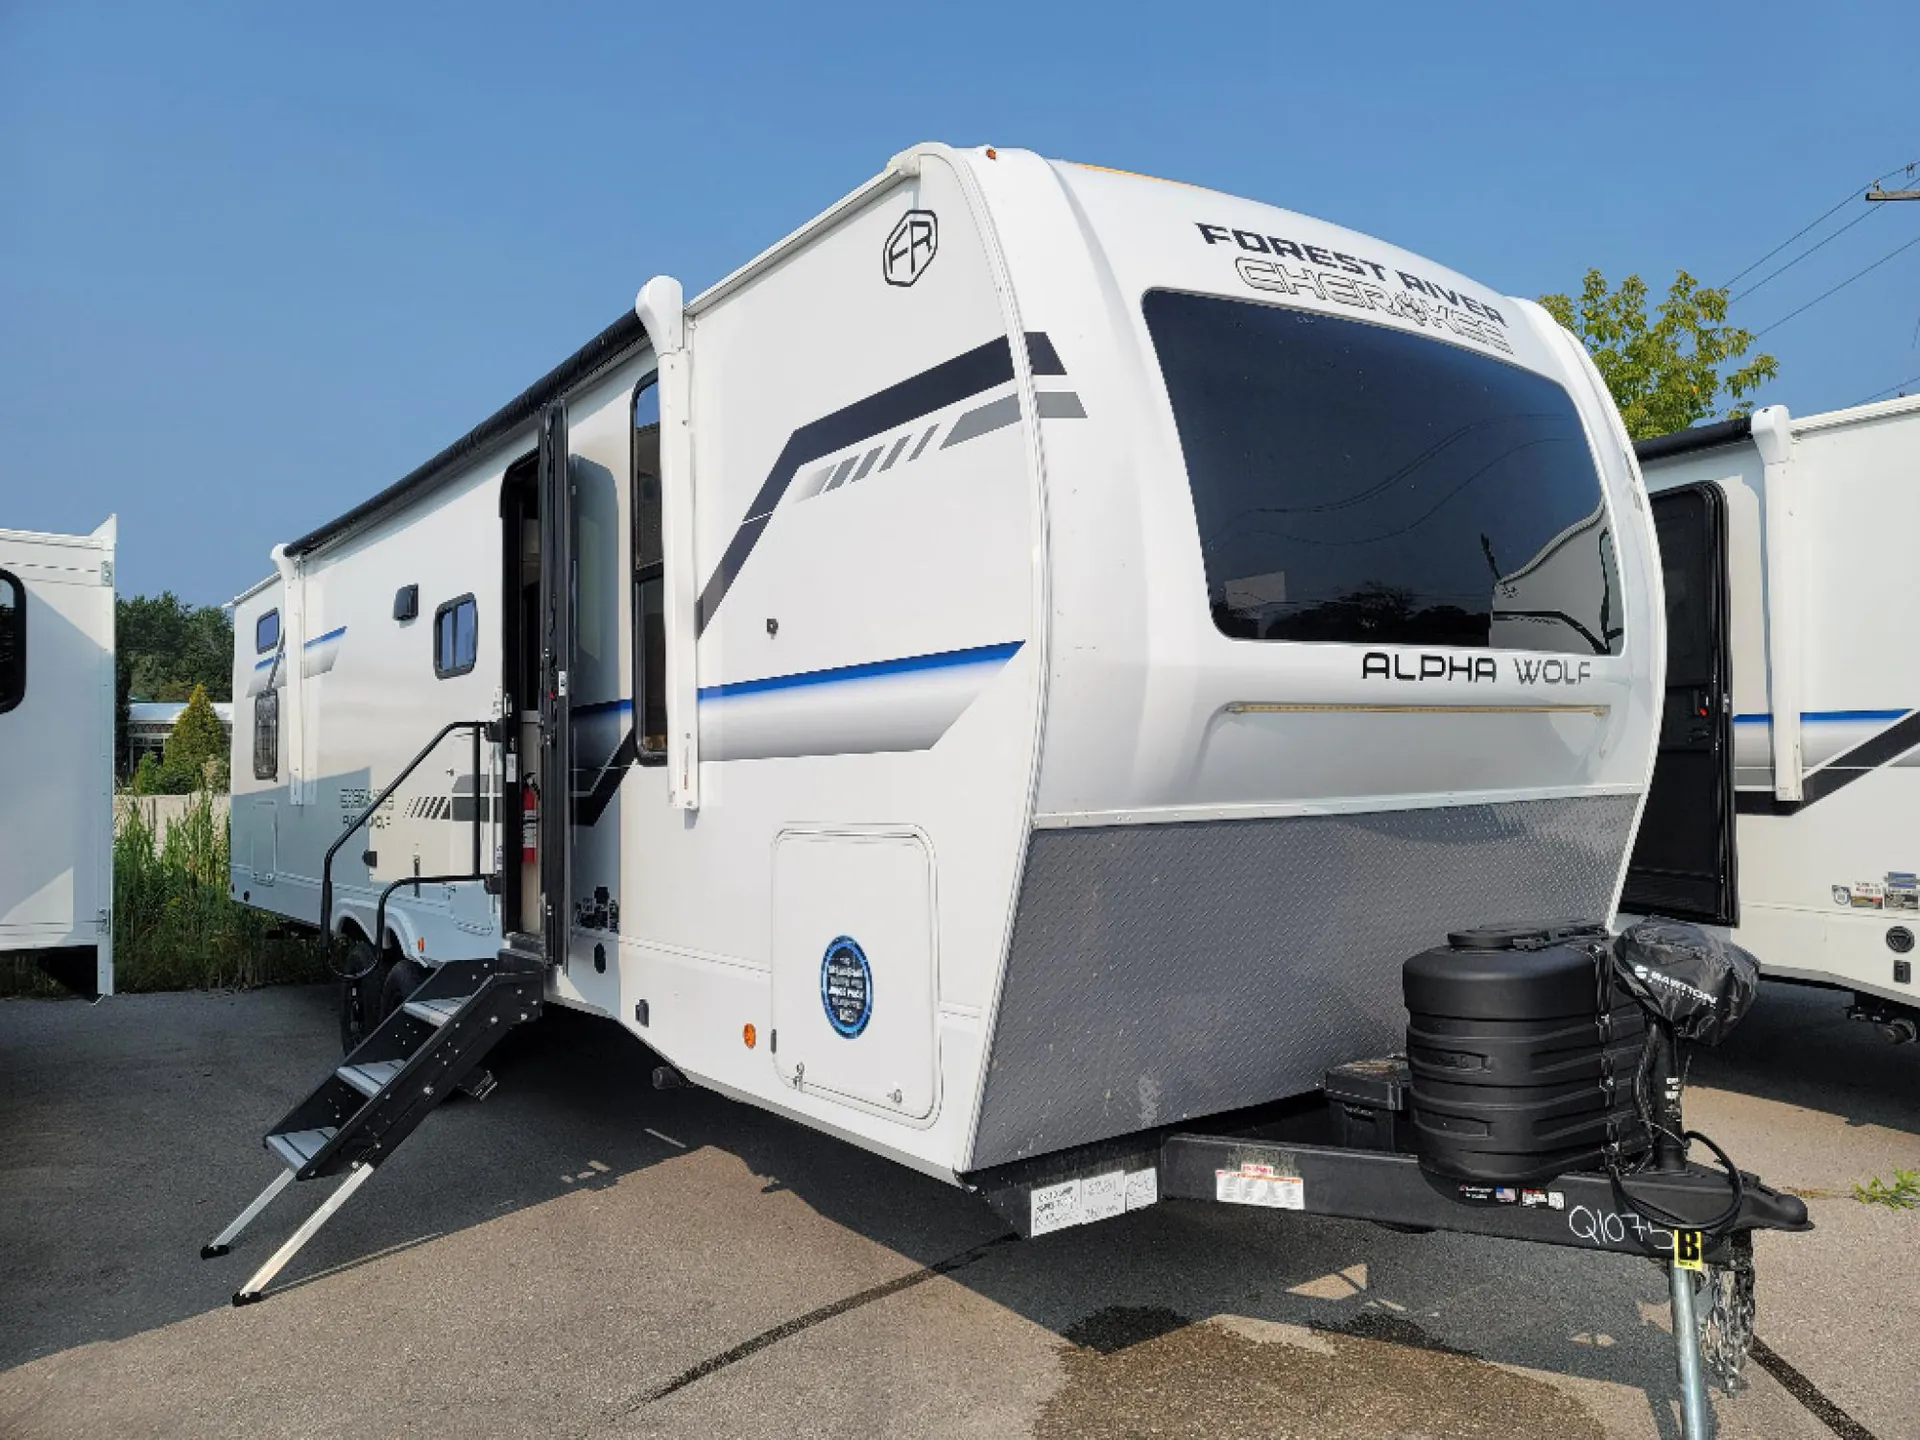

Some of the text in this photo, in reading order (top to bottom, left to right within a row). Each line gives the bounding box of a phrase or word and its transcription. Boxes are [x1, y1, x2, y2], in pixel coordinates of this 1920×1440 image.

[1195, 222, 1509, 328] FOREST RIVER
[1235, 256, 1515, 355] CHEROKEE
[1361, 652, 1592, 686] ALPHA WOLF
